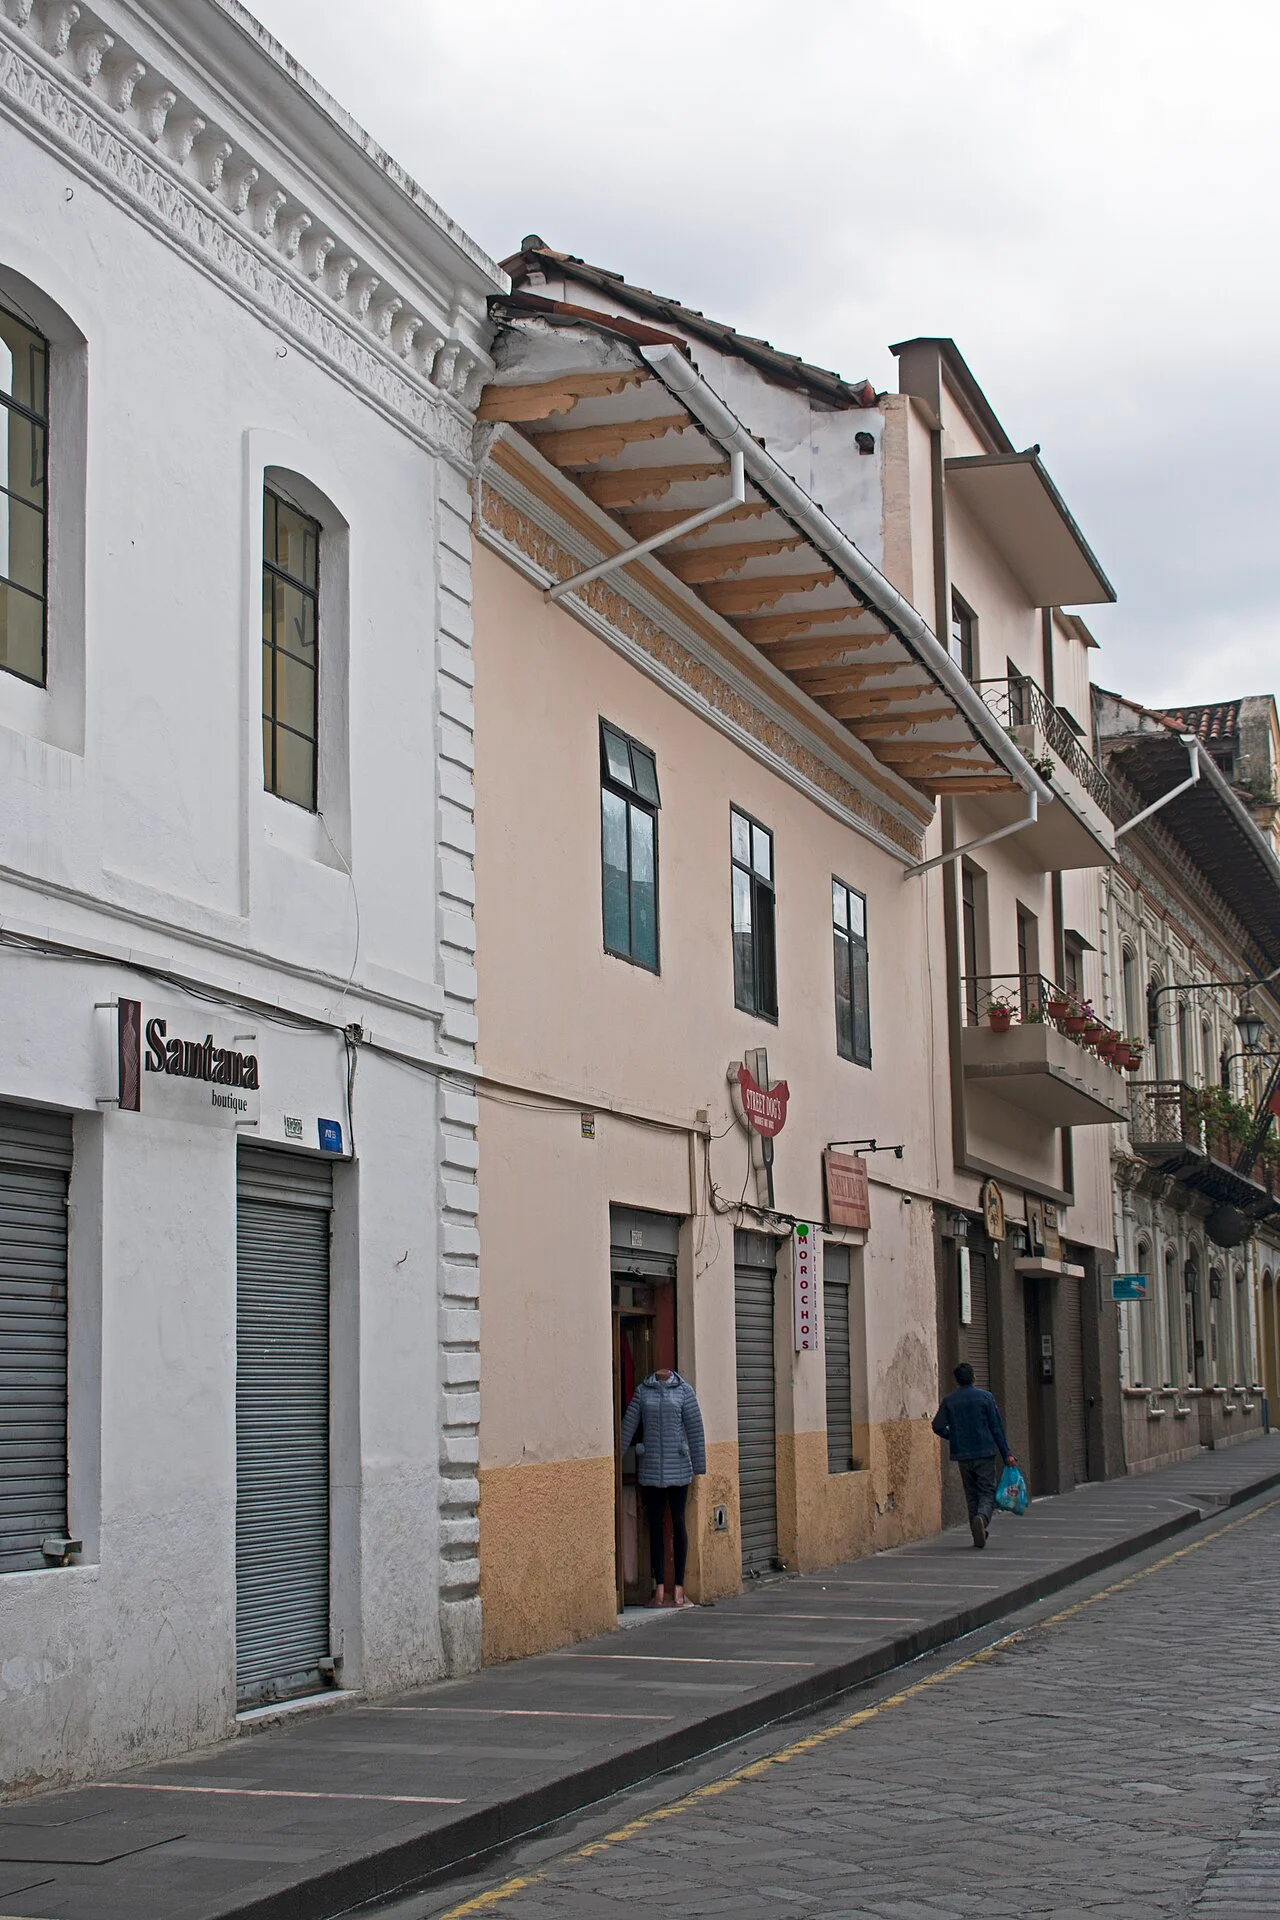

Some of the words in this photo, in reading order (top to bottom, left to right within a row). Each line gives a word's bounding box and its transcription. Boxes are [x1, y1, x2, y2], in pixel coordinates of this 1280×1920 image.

[145, 1017, 260, 1090] Santana
[211, 1089, 248, 1114] boutique
[746, 1088, 765, 1114] STREET
[766, 1096, 781, 1120] DOG'S
[798, 1236, 809, 1350] MOROCHOS
